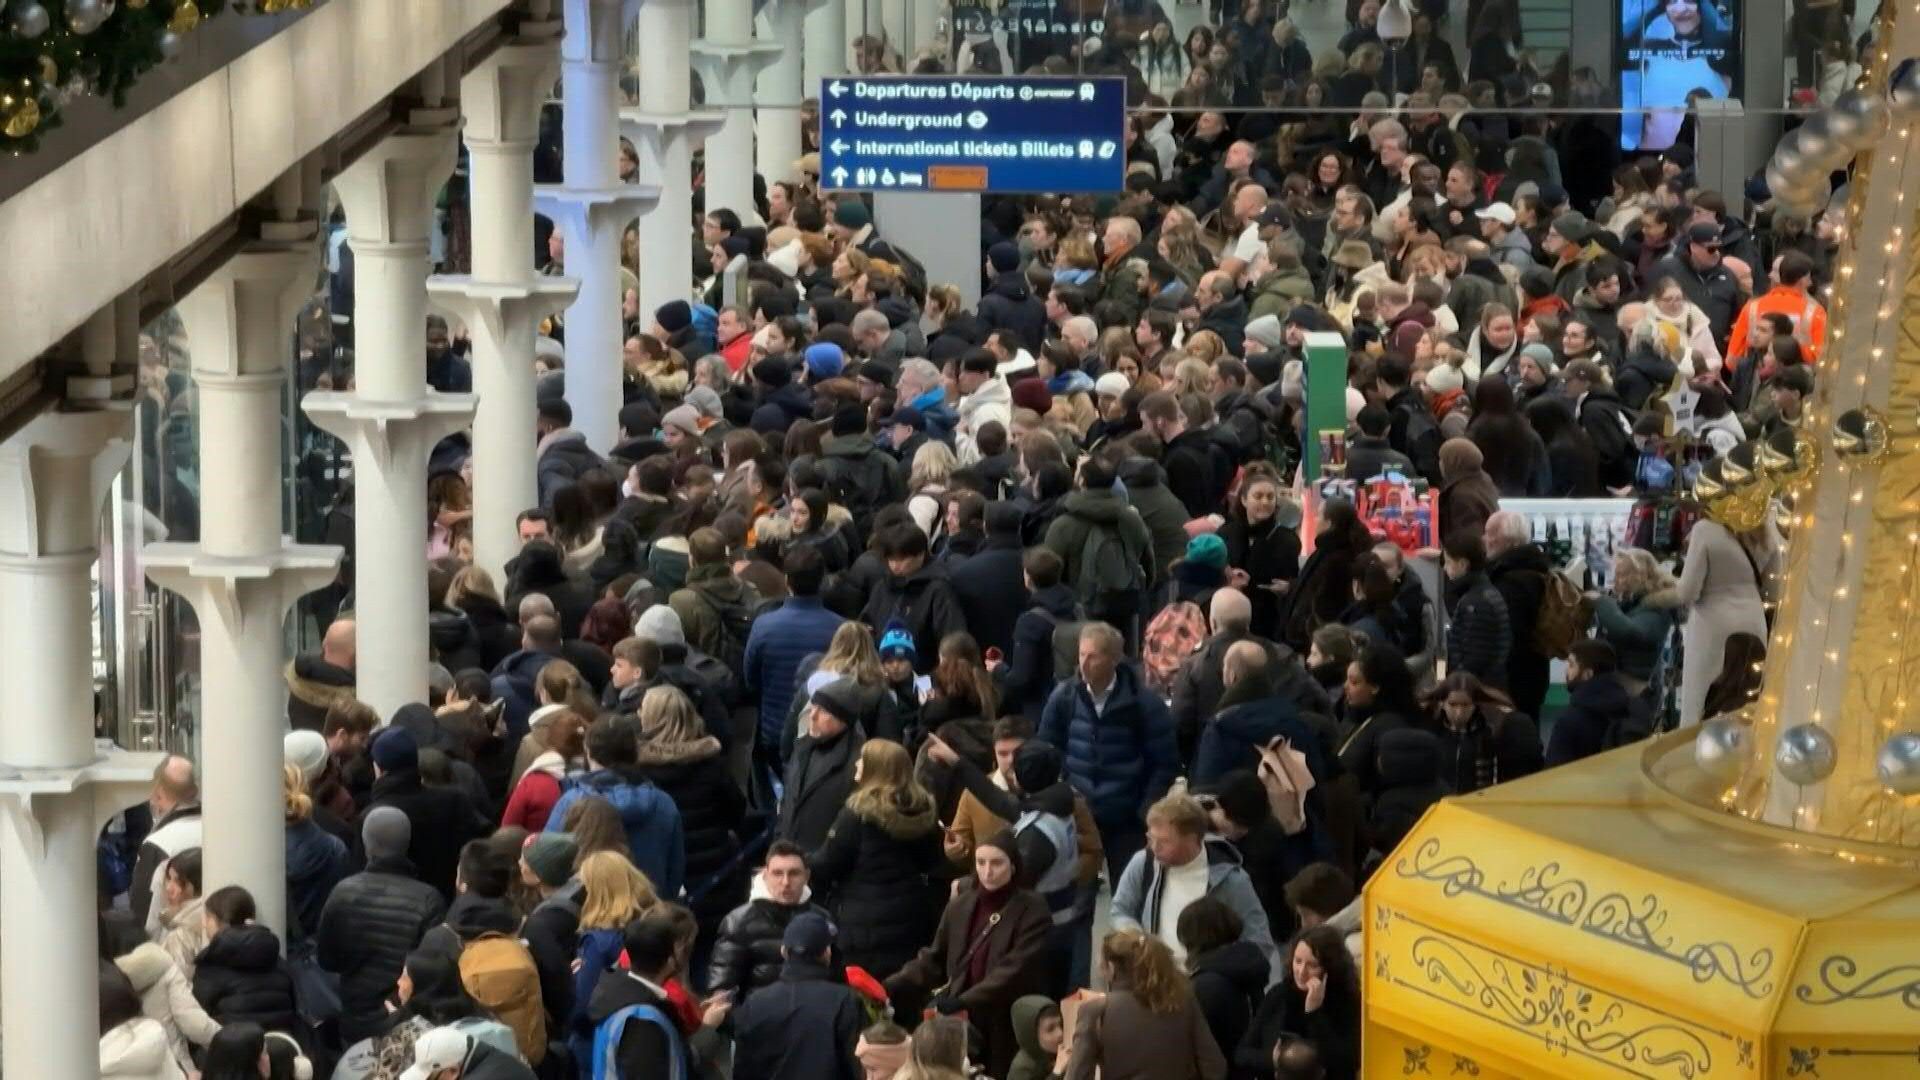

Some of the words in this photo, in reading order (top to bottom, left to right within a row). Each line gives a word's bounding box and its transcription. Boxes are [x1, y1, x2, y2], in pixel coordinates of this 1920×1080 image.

[854, 81, 947, 101] Departures
[950, 81, 1015, 102] Départs
[854, 110, 963, 131] Underground
[855, 139, 960, 158] International
[962, 139, 1018, 159] tickets
[1021, 139, 1074, 159] Billets
